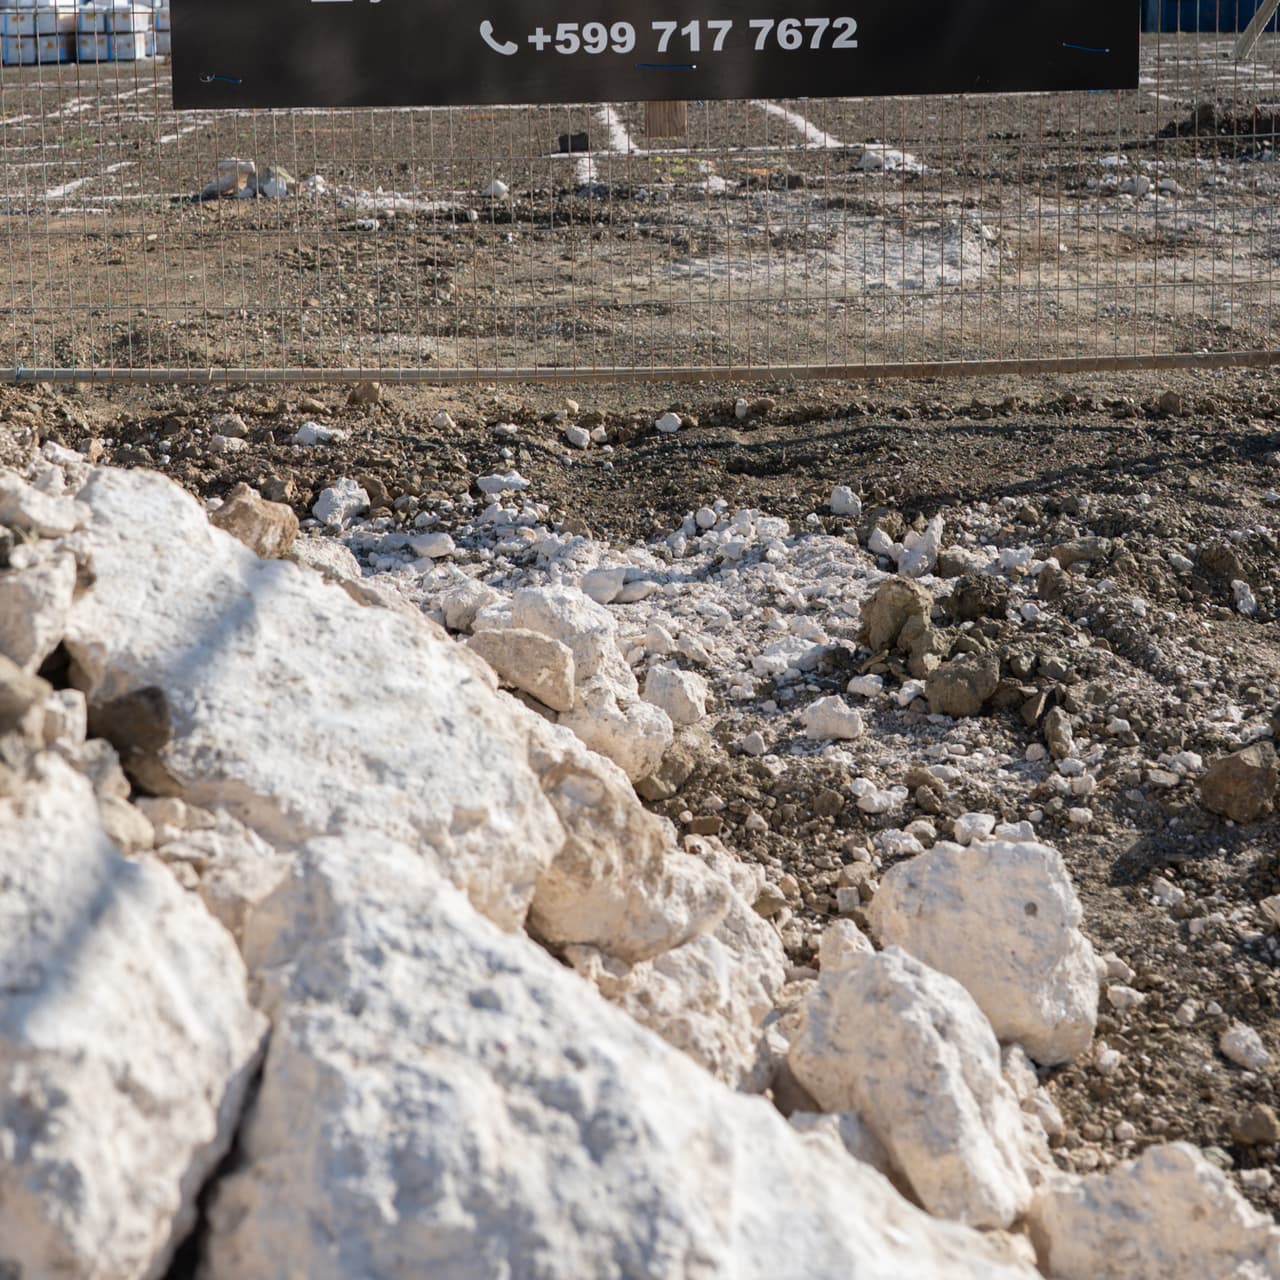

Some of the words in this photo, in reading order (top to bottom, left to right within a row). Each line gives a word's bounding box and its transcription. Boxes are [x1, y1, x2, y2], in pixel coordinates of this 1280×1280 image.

[527, 21, 636, 55] +599
[651, 19, 733, 53] 717
[748, 16, 858, 51] 7672
